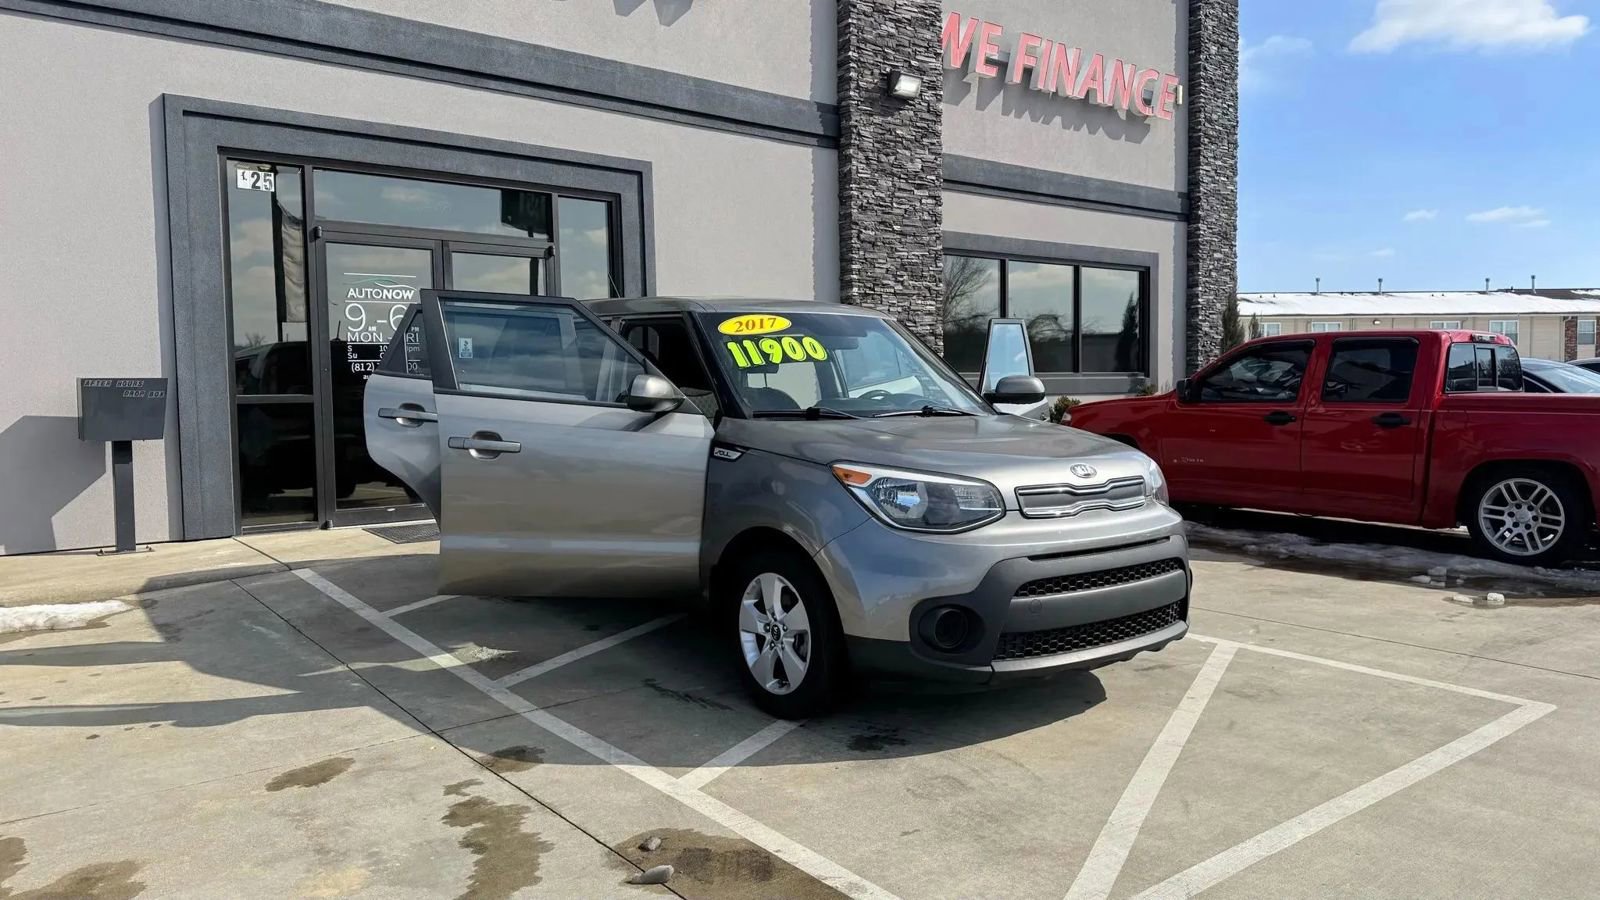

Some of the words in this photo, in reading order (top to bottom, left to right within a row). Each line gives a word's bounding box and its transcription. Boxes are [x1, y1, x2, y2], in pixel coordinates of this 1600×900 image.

[942, 12, 1003, 77] WE
[1012, 32, 1179, 120] FINANCE
[347, 288, 415, 300] AUTONOW
[345, 303, 366, 332] 9
[734, 317, 777, 332] 2017
[347, 332, 383, 342] MON
[406, 332, 419, 342] RI
[727, 336, 828, 368] 11900
[351, 361, 375, 373] (812)
[115, 380, 144, 388] HOURS
